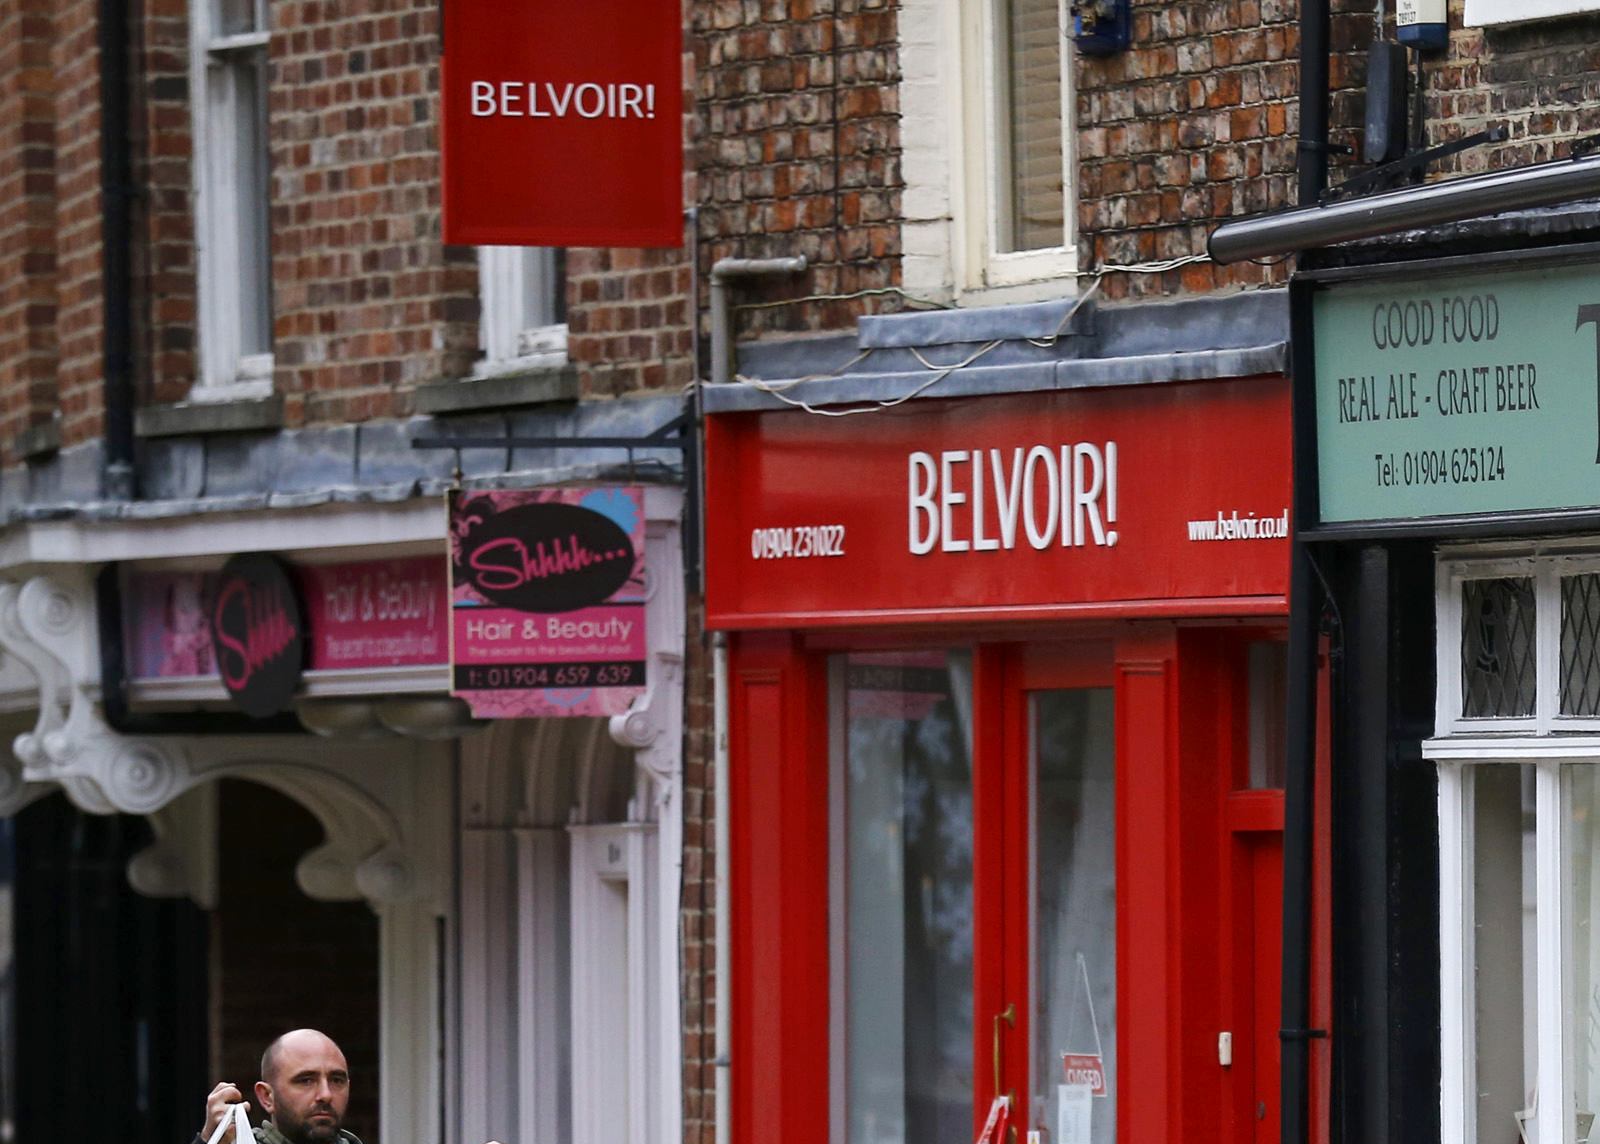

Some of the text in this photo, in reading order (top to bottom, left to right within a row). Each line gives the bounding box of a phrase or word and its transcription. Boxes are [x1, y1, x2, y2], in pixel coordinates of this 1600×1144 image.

[470, 81, 657, 119] BELVOIR!
[1373, 293, 1499, 350] GOOD FOOD
[1338, 375, 1380, 424] REAL
[1387, 372, 1419, 420] ALE
[1437, 366, 1489, 417] CRAFT
[1495, 363, 1540, 412] BEER
[1375, 445, 1505, 486] Tel: 01904 625124
[908, 441, 1118, 556] BELVOIR!
[752, 524, 845, 559] 01904 231022
[466, 616, 633, 641] Hair & Beauty
[487, 668, 548, 686] 01904
[555, 666, 589, 684] 659
[597, 665, 632, 683] 639
